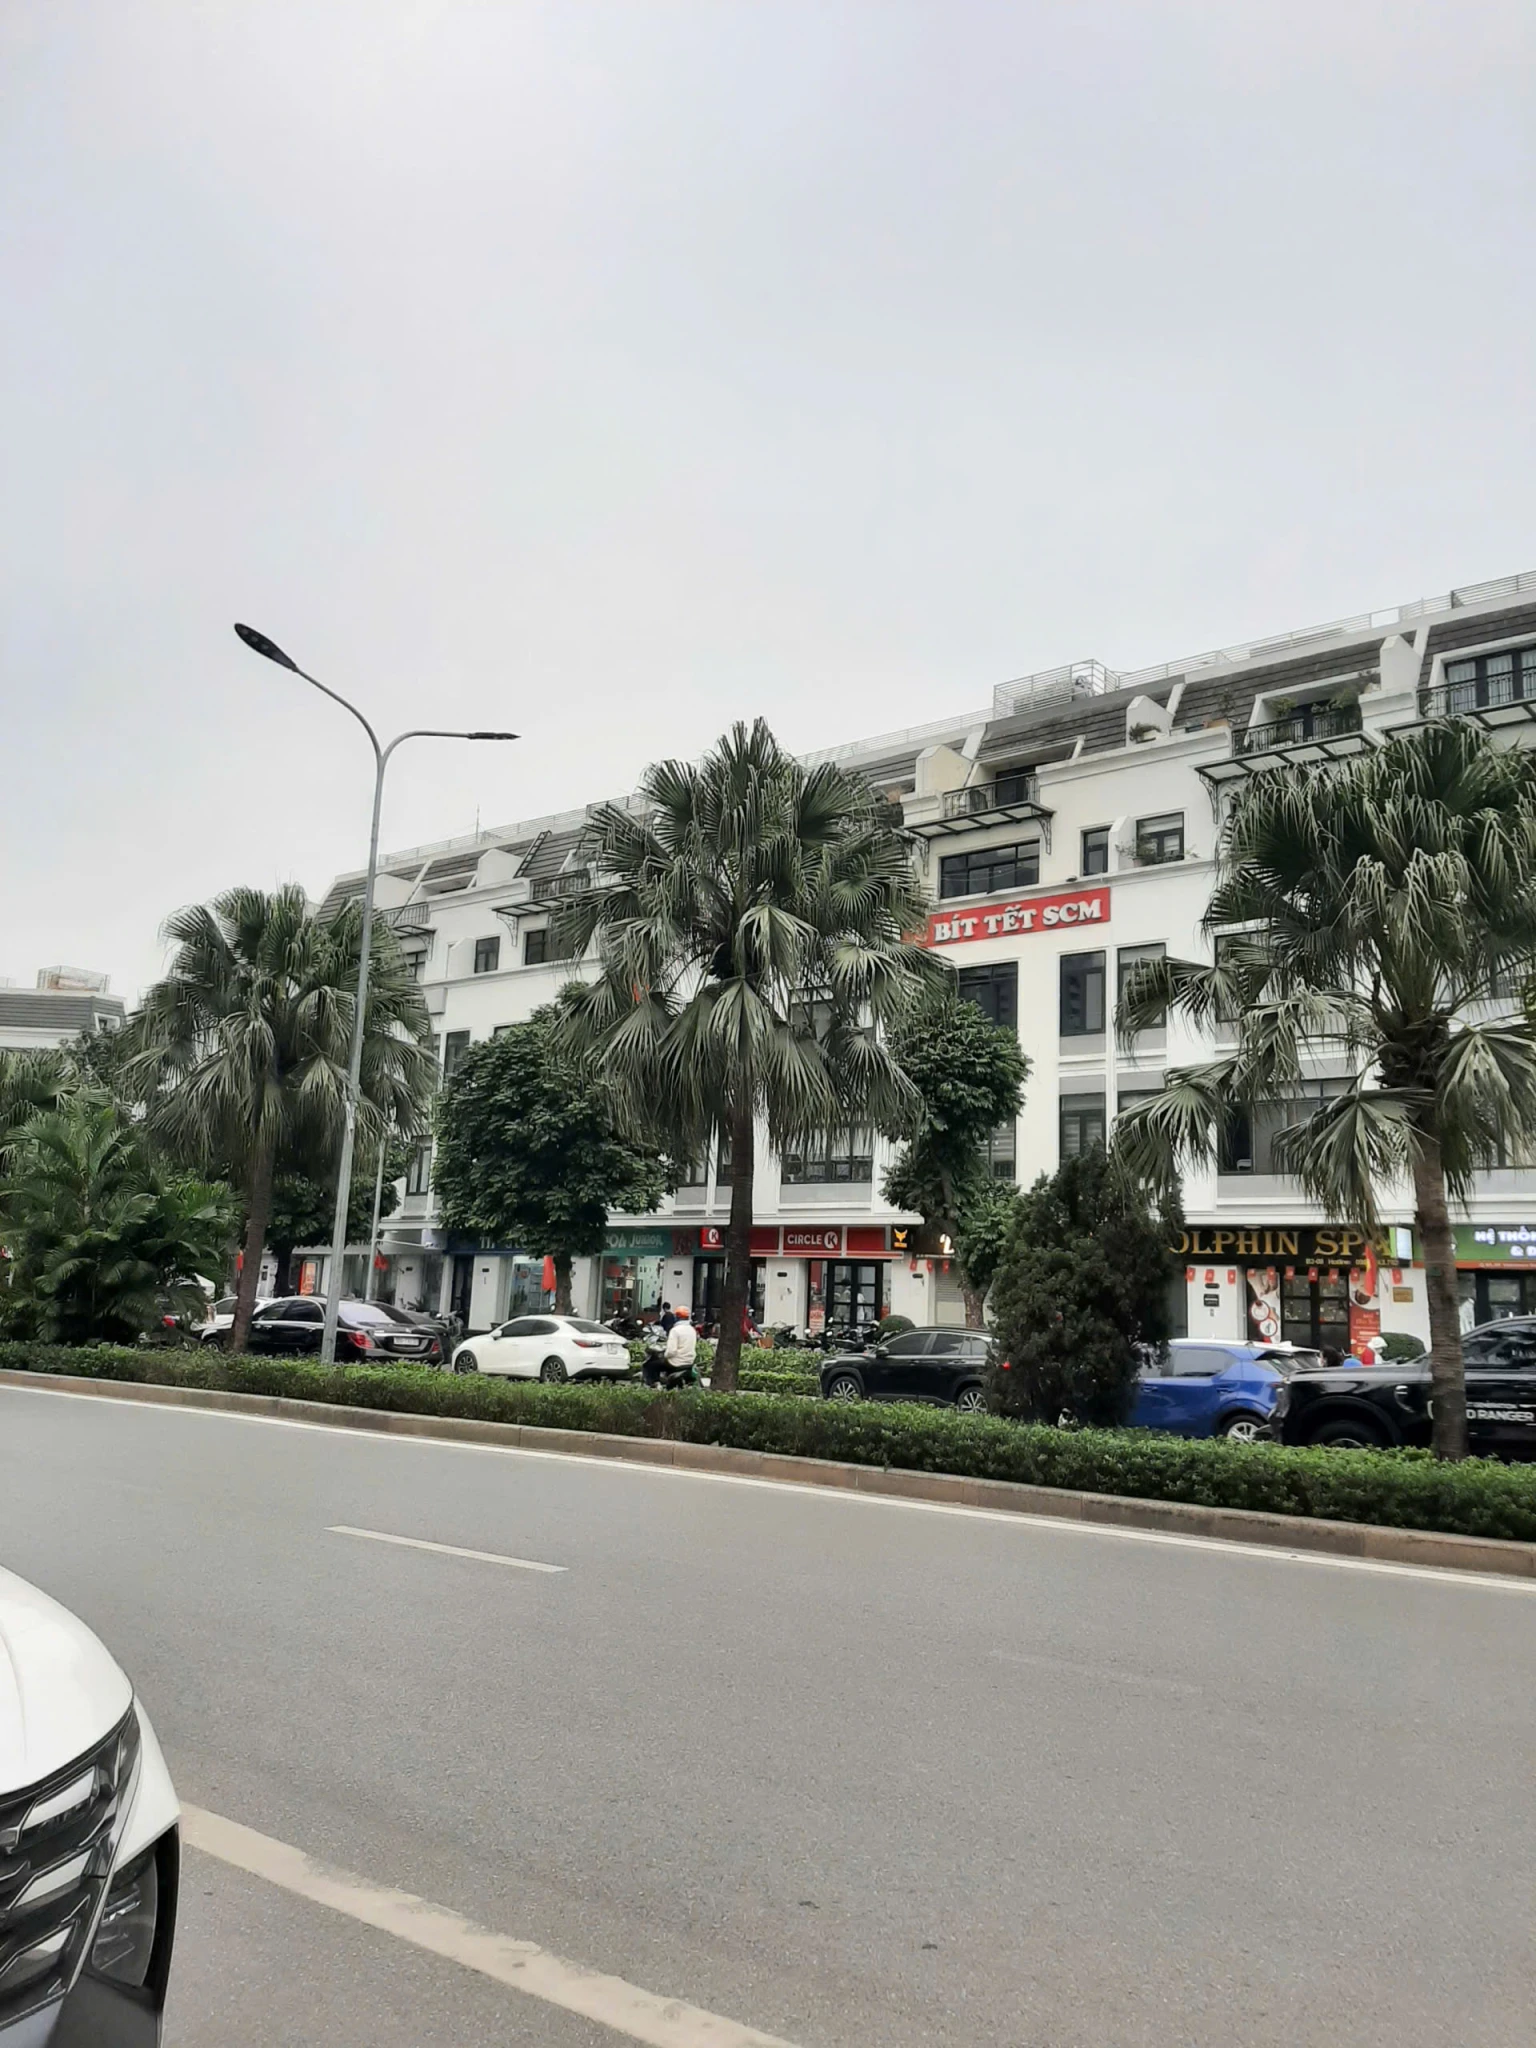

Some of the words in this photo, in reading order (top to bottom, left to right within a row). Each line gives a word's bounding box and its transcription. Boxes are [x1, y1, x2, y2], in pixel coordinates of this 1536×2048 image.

[933, 913, 978, 942] BÍT
[983, 904, 1037, 934] TẾT
[1042, 898, 1102, 926] SCM
[787, 1234, 822, 1245] CIRCLE
[824, 1231, 838, 1249] K
[1168, 1230, 1300, 1256] OLPHIN
[1477, 1409, 1534, 1422] RANGER
